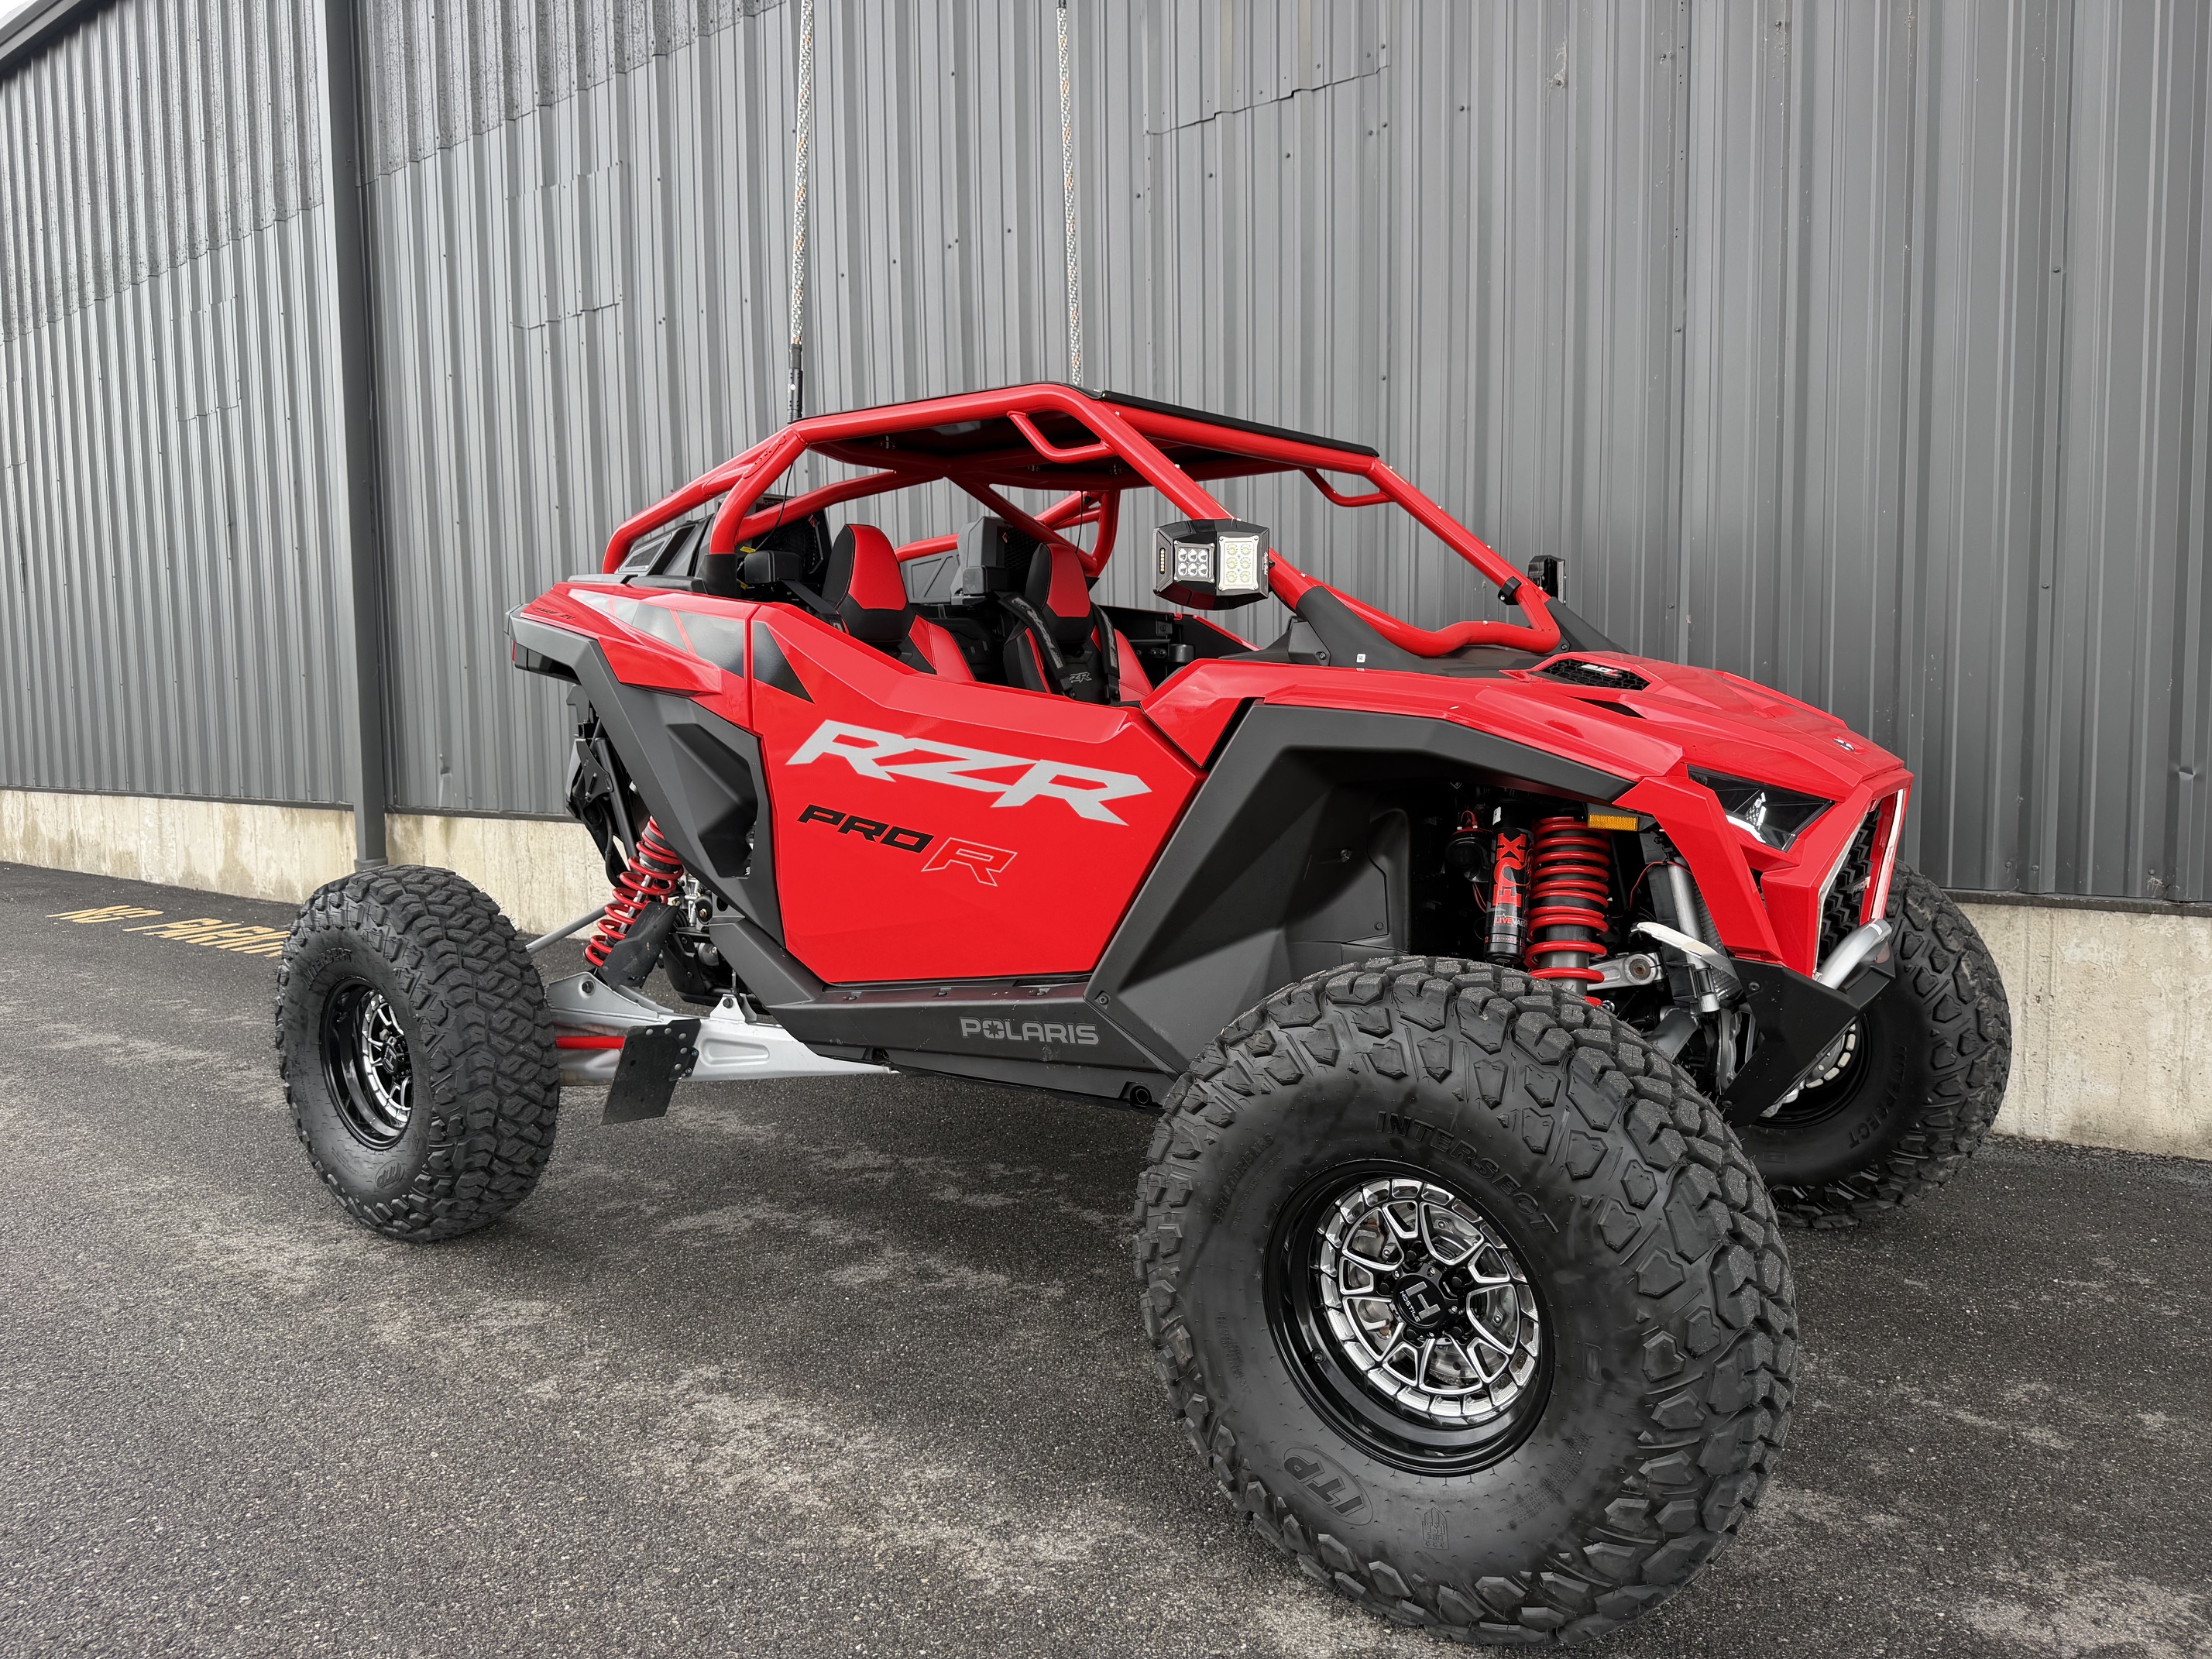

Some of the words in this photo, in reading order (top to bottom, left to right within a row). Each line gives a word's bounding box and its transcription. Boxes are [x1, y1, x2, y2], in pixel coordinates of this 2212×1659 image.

[785, 719, 1152, 826] RZR
[797, 803, 934, 854] PRO
[921, 836, 1018, 887] R
[1492, 833, 1527, 908] FOX
[45, 905, 164, 923] NO
[959, 1017, 1100, 1046] POLARIS
[376, 1162, 403, 1189] ITP
[1376, 1110, 1559, 1234] INTERSECT
[1400, 1290, 1421, 1323] HOSTILE
[1284, 1455, 1365, 1516] ITP
